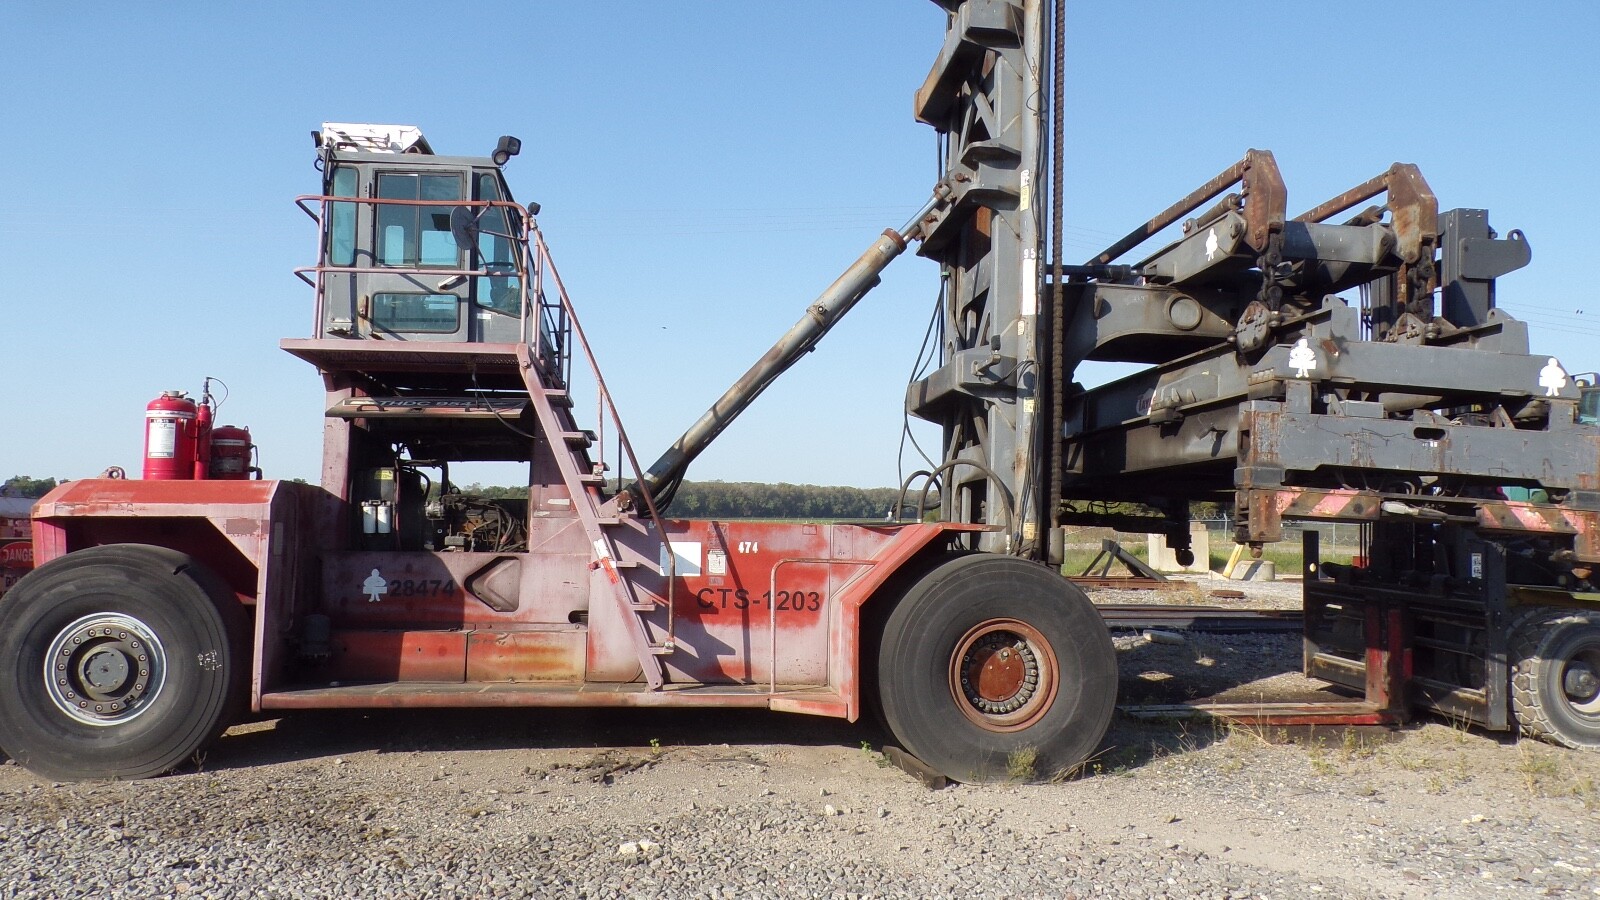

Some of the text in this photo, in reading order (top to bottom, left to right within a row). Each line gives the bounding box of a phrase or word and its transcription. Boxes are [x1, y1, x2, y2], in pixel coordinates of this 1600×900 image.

[2, 548, 33, 562] DANGE
[738, 541, 758, 553] 474
[389, 579, 454, 597] 28474
[696, 587, 820, 612] CTS-1203
